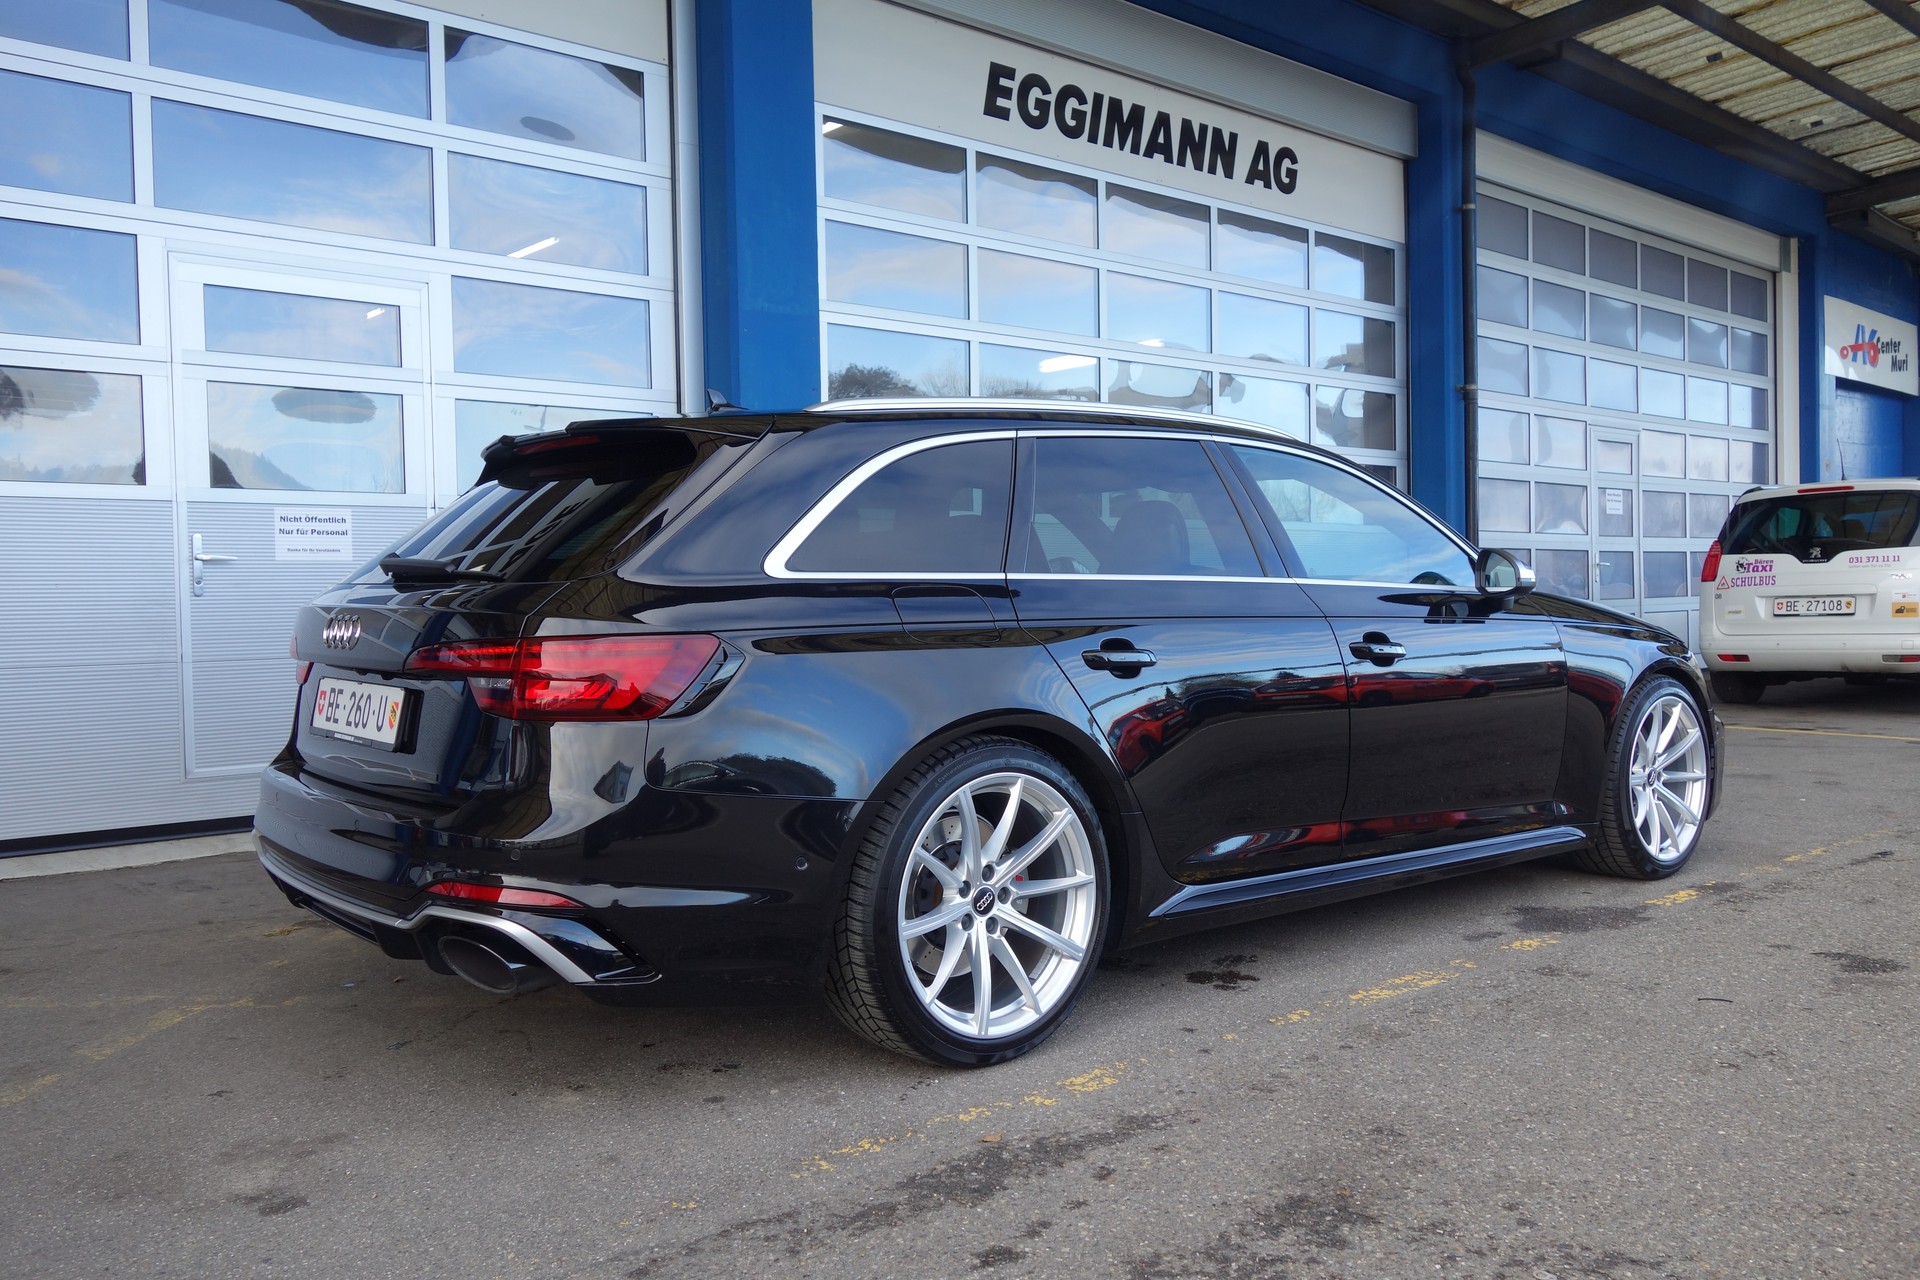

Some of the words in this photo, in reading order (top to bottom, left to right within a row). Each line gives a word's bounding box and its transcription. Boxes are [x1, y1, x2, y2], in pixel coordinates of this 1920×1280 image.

[983, 61, 1239, 180] EGGIMANN
[1244, 139, 1299, 195] AG
[1876, 336, 1902, 354] Center
[1891, 353, 1908, 373] Muri
[279, 515, 303, 523] Nicht
[304, 514, 347, 524] Öffentlich
[296, 528, 309, 536] für
[310, 528, 348, 536] Personal
[1848, 556, 1863, 564] 031
[1865, 555, 1879, 563] 371
[1881, 555, 1890, 563] 11
[1892, 554, 1901, 562] 11
[1745, 562, 1774, 573] Taxi
[1730, 575, 1777, 588] SCHULBUS
